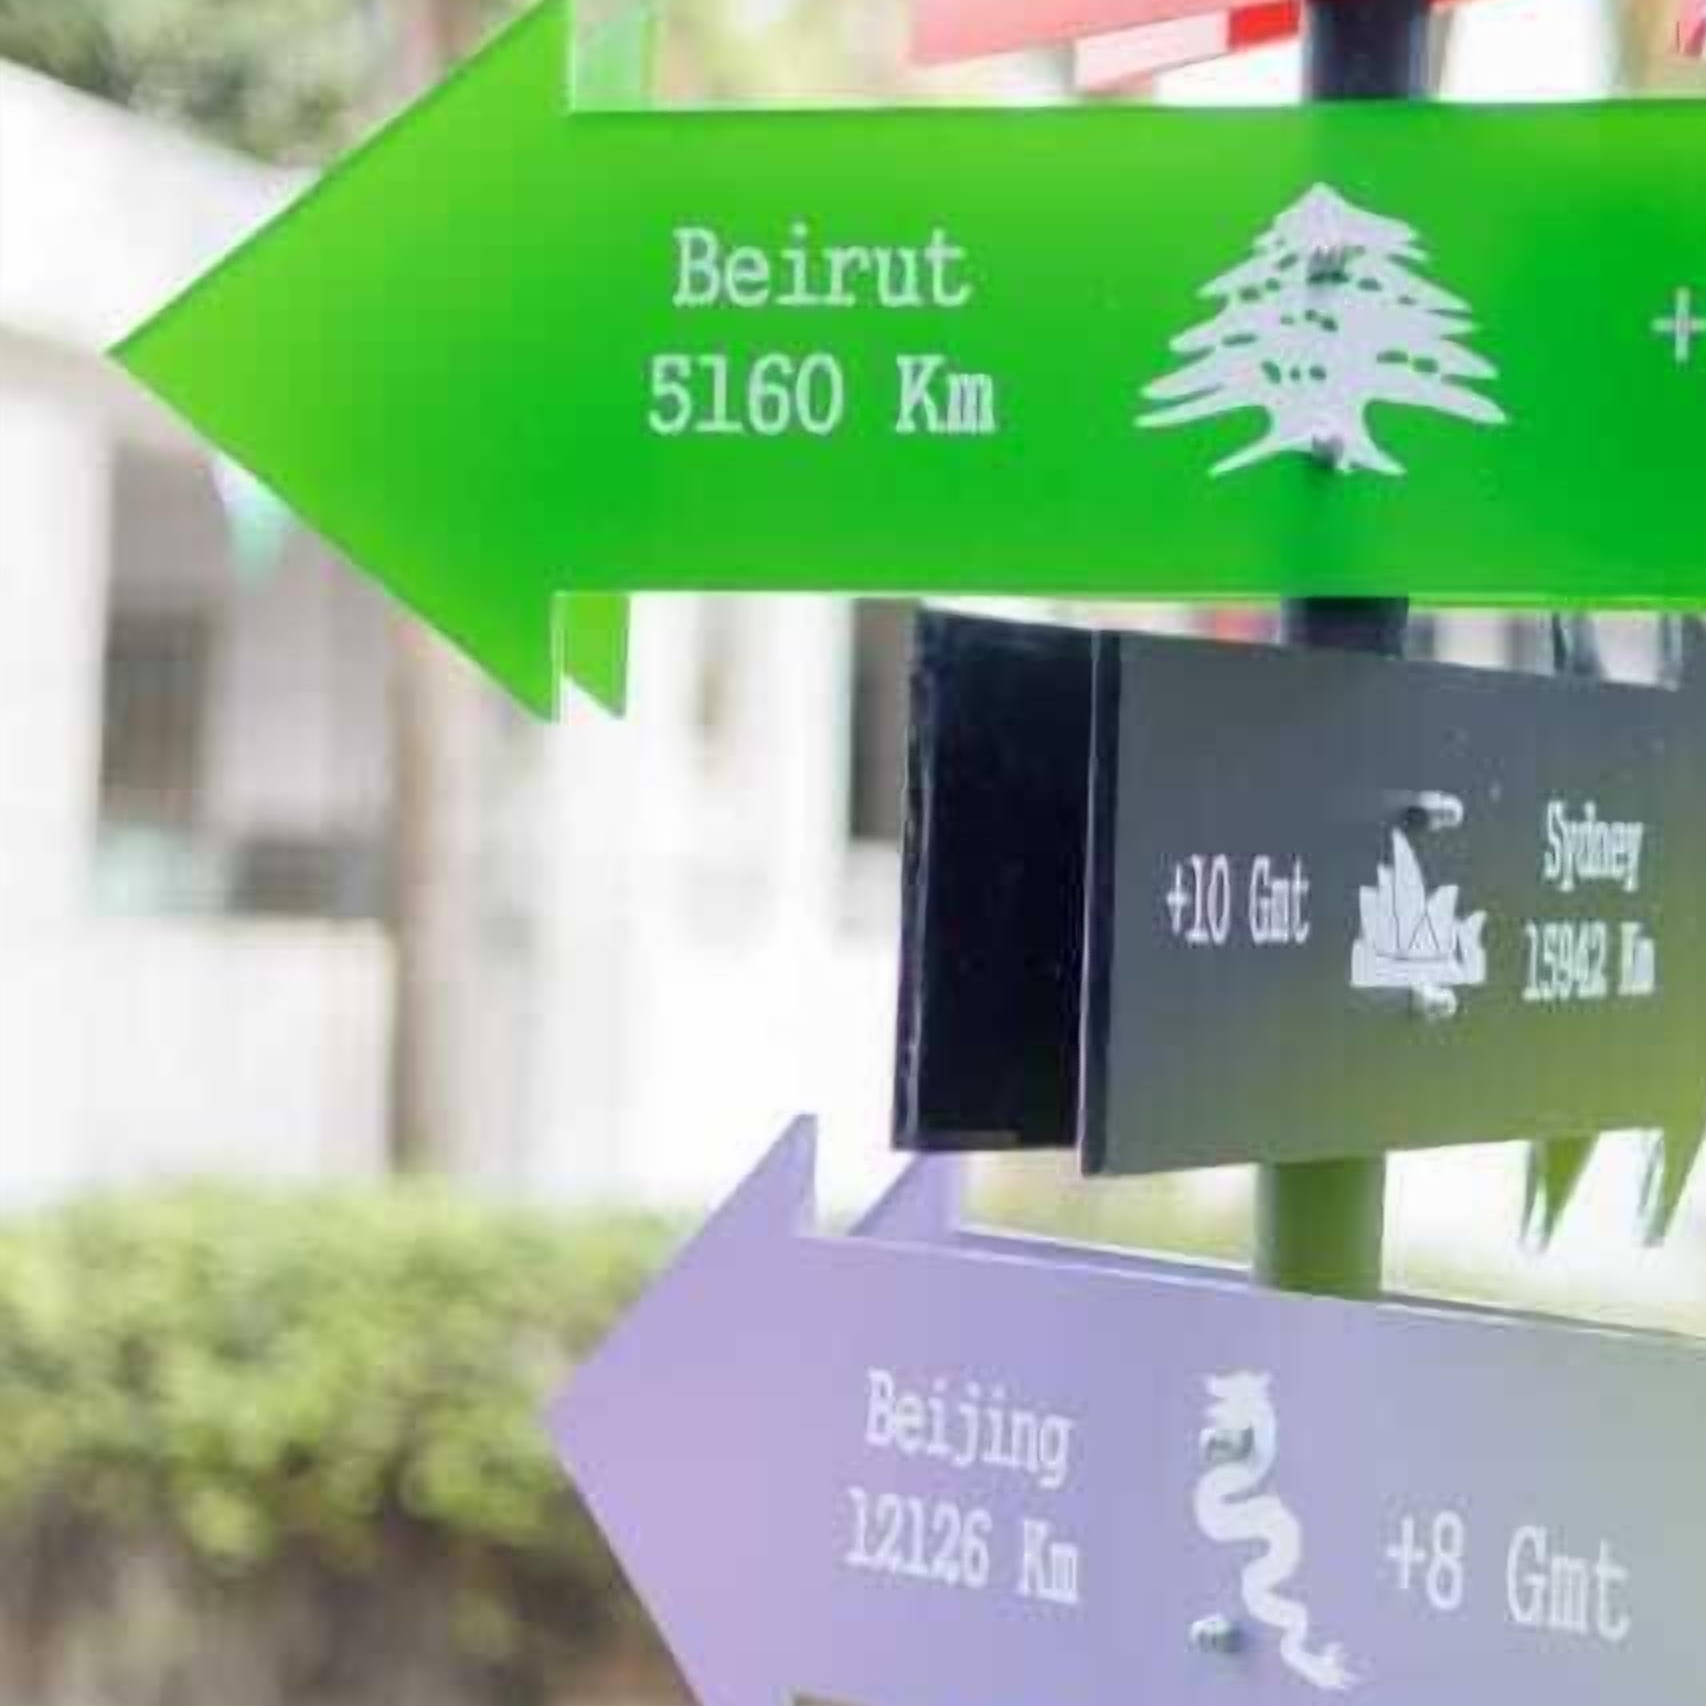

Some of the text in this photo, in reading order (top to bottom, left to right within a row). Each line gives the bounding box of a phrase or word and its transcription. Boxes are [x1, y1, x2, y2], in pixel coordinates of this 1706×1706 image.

[671, 222, 974, 308] Beirut
[647, 352, 997, 436] 5160 Km
[1543, 800, 1645, 893] Sydney
[1165, 854, 1310, 945] +10 Gmt
[1617, 921, 1655, 997] Km
[865, 1367, 1075, 1488] Beijing
[843, 1488, 1082, 1605] 12126 Km
[1385, 1512, 1632, 1643] +8 Gmt
